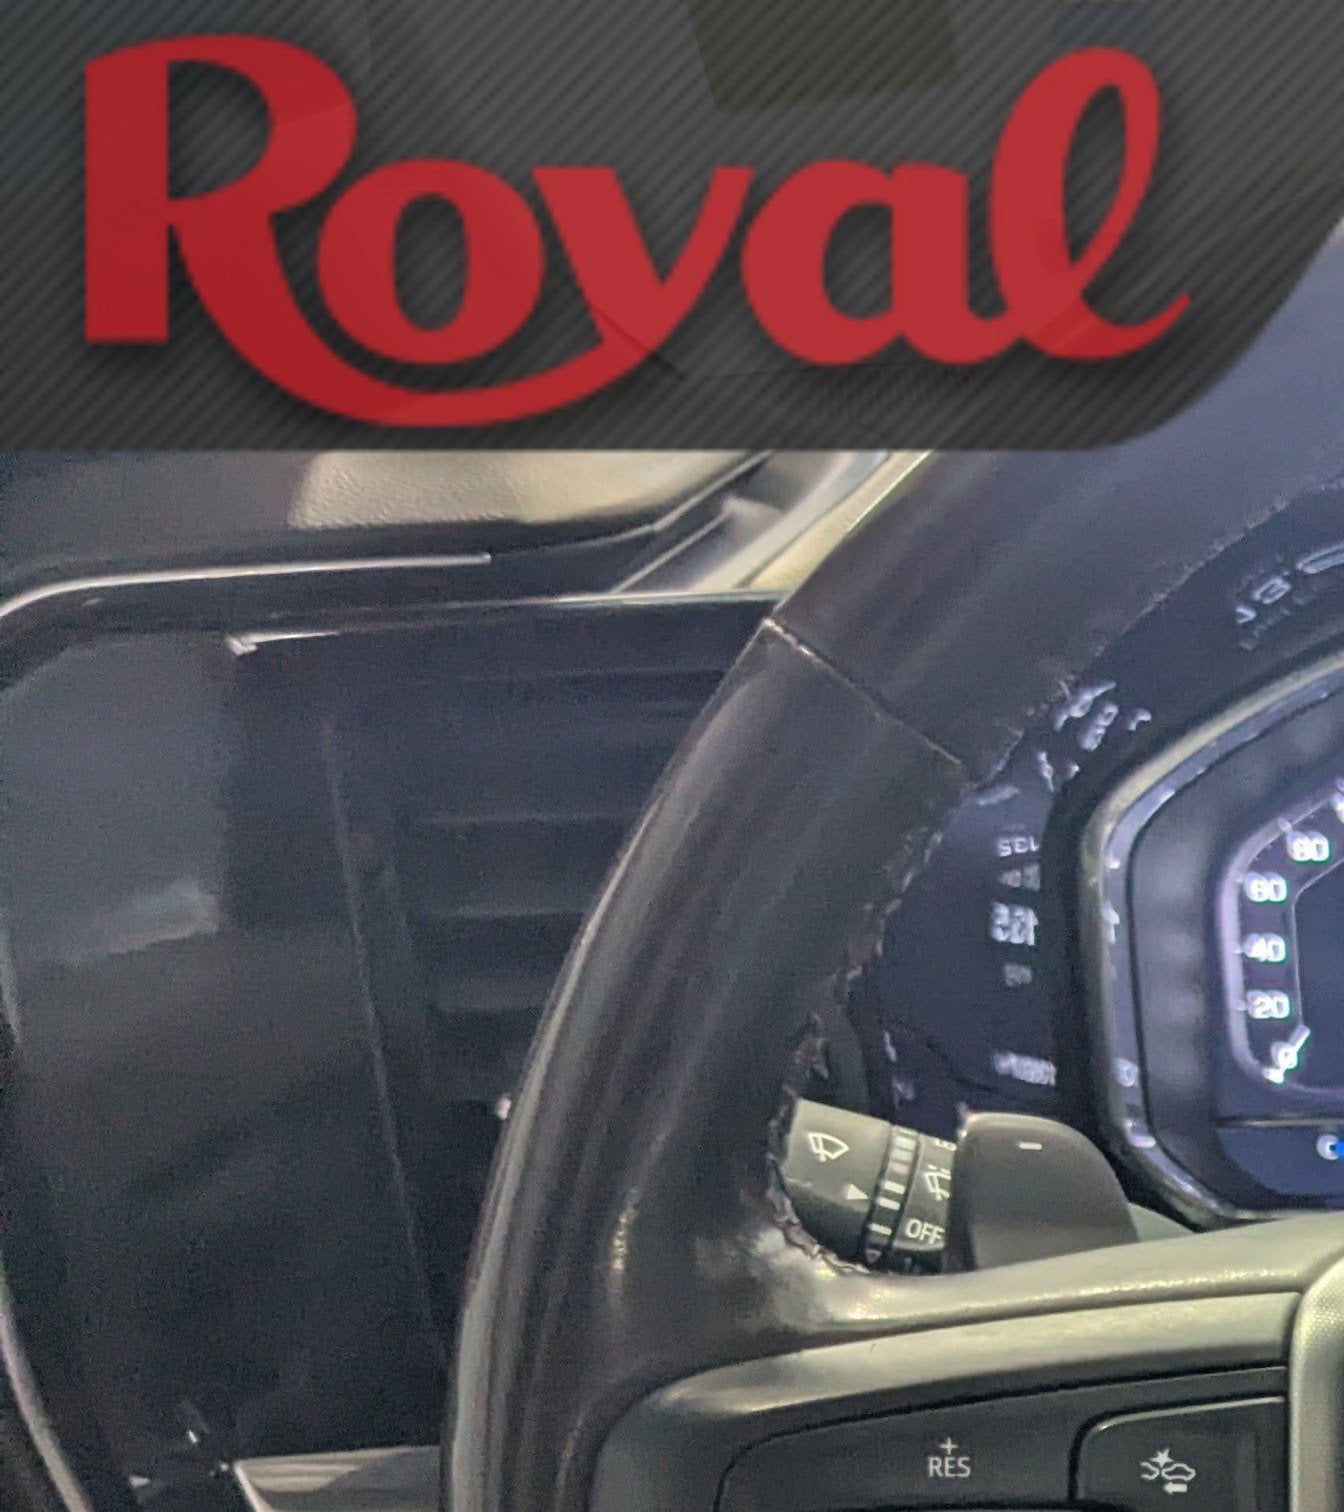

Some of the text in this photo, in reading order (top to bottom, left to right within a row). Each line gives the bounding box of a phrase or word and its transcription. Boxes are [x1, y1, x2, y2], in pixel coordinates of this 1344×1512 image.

[1286, 831, 1330, 862] 80
[1244, 933, 1287, 962] 40
[1246, 990, 1290, 1020] 20
[905, 1217, 946, 1247] OFF
[927, 1454, 971, 1479] RES
